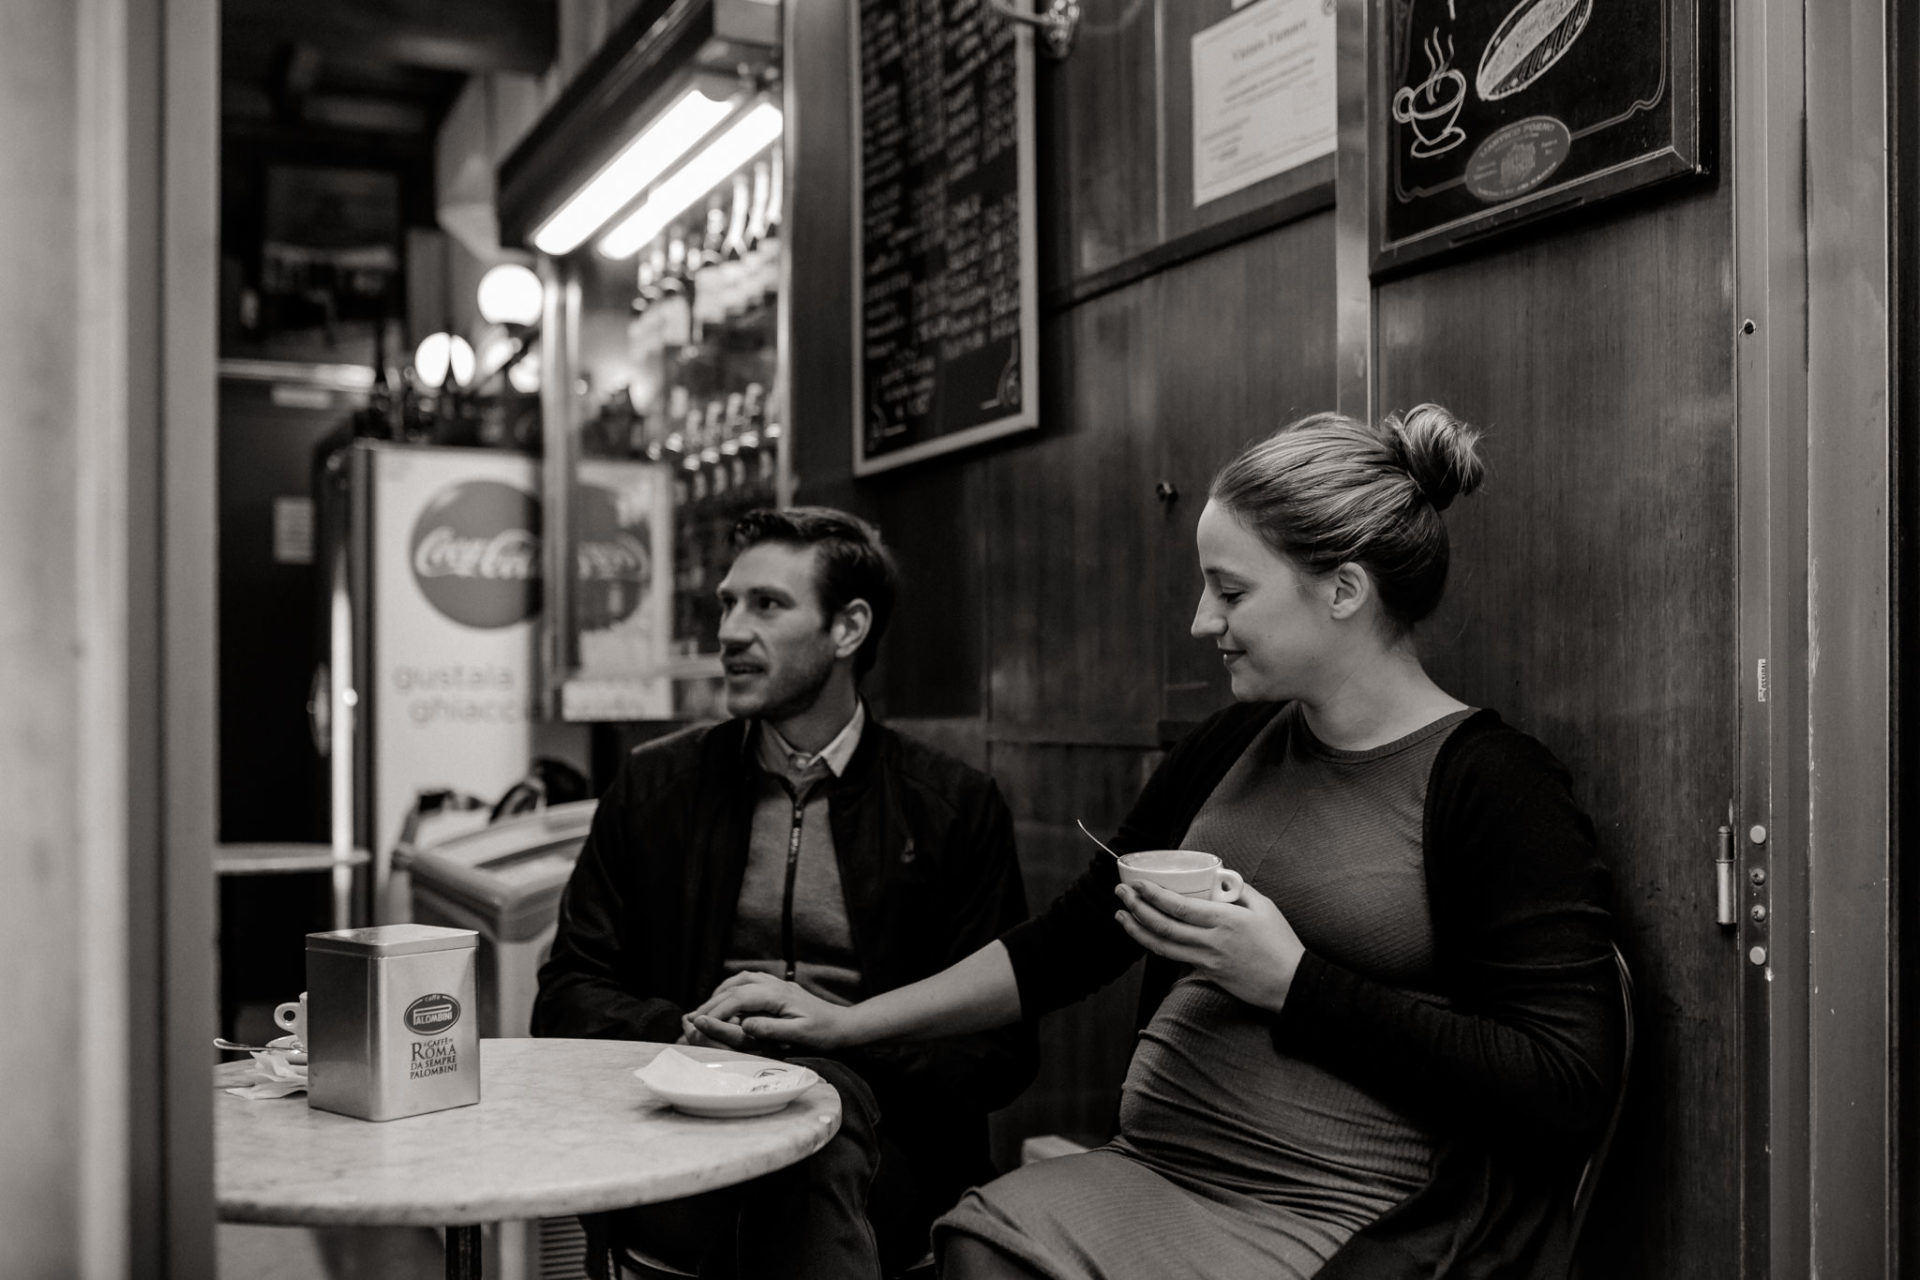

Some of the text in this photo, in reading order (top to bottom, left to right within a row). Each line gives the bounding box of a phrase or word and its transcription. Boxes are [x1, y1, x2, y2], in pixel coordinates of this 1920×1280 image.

[413, 1004, 452, 1025] PALOMBINI
[411, 1042, 456, 1061] ROMA
[410, 1055, 457, 1071] DA SEMPRE
[410, 1063, 457, 1080] PALOMBINI
